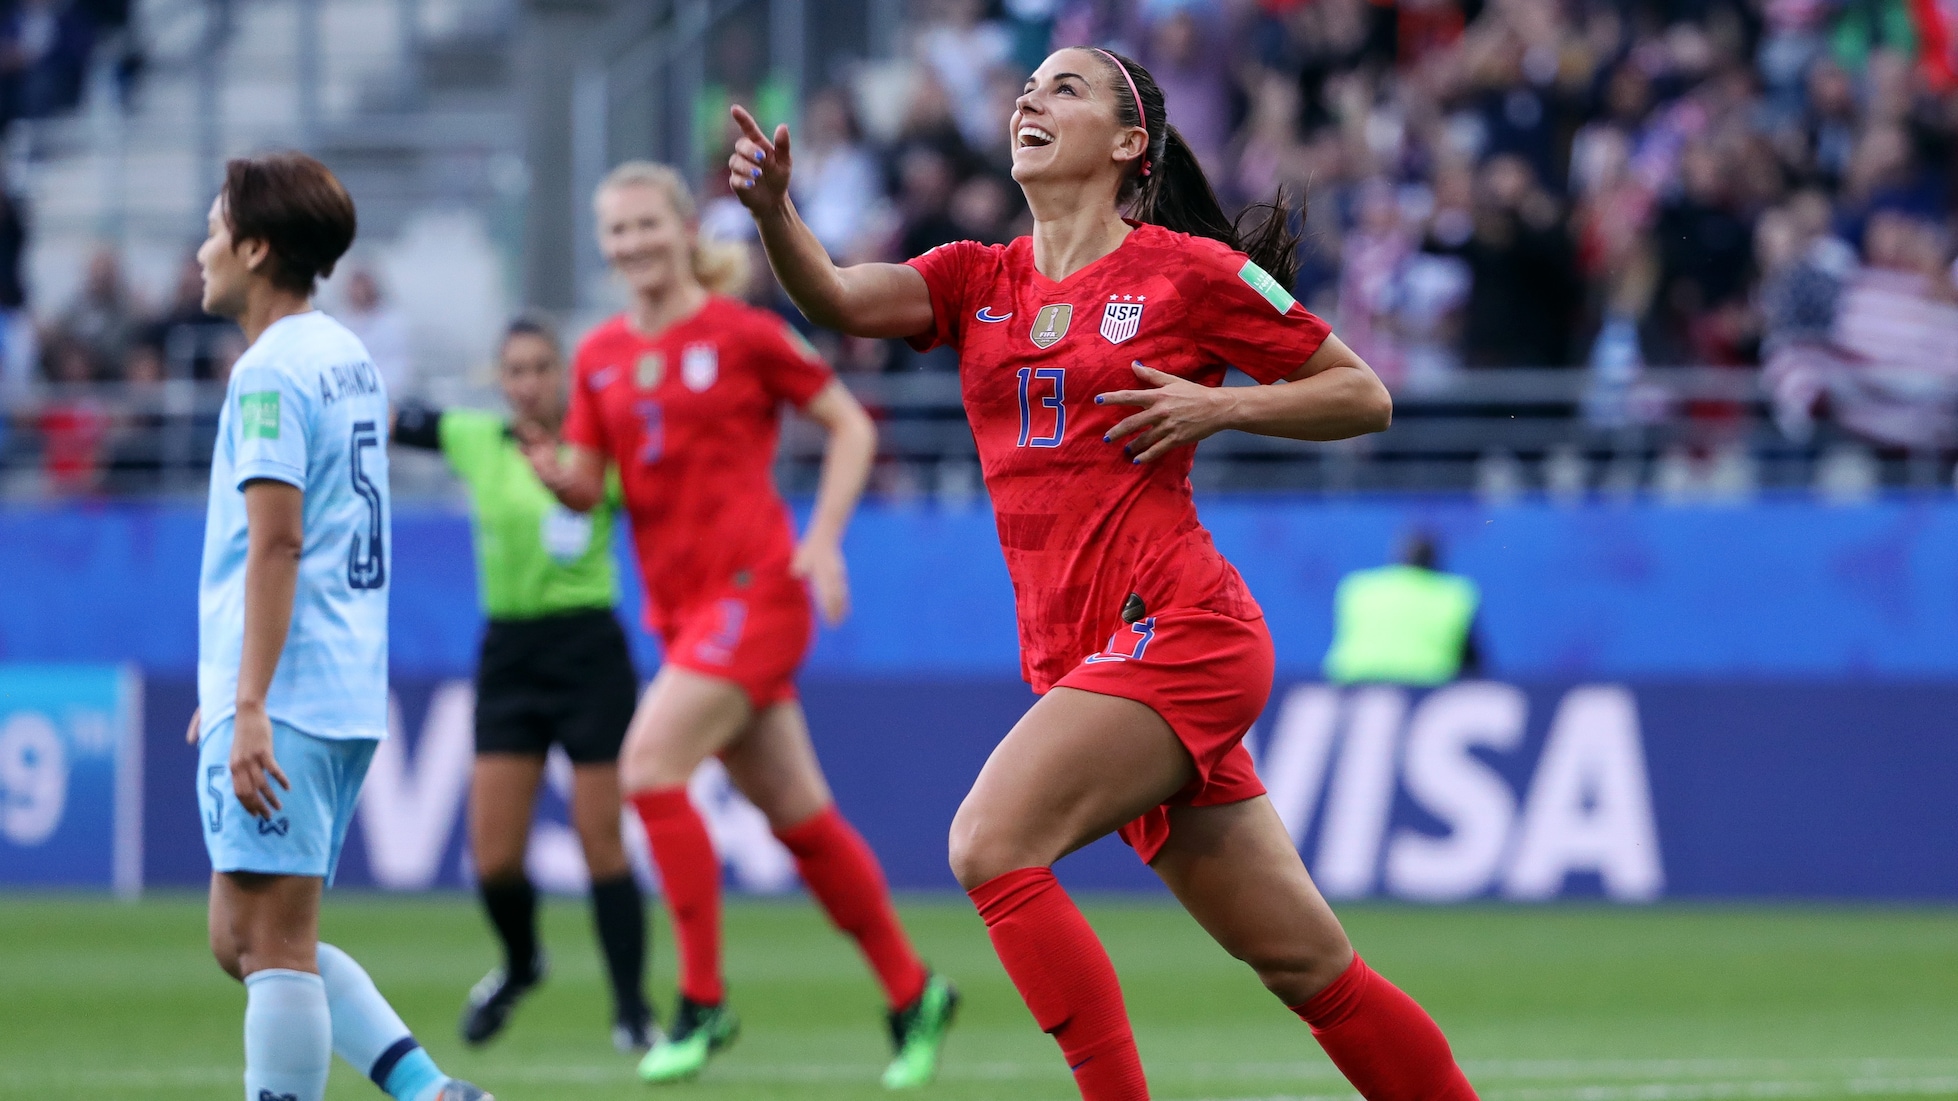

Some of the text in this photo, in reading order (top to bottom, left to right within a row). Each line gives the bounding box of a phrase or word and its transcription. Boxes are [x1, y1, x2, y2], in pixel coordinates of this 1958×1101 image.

[1107, 305, 1140, 321] USA
[1017, 368, 1066, 448] 13
[348, 422, 385, 589] 5
[208, 765, 226, 833] 5
